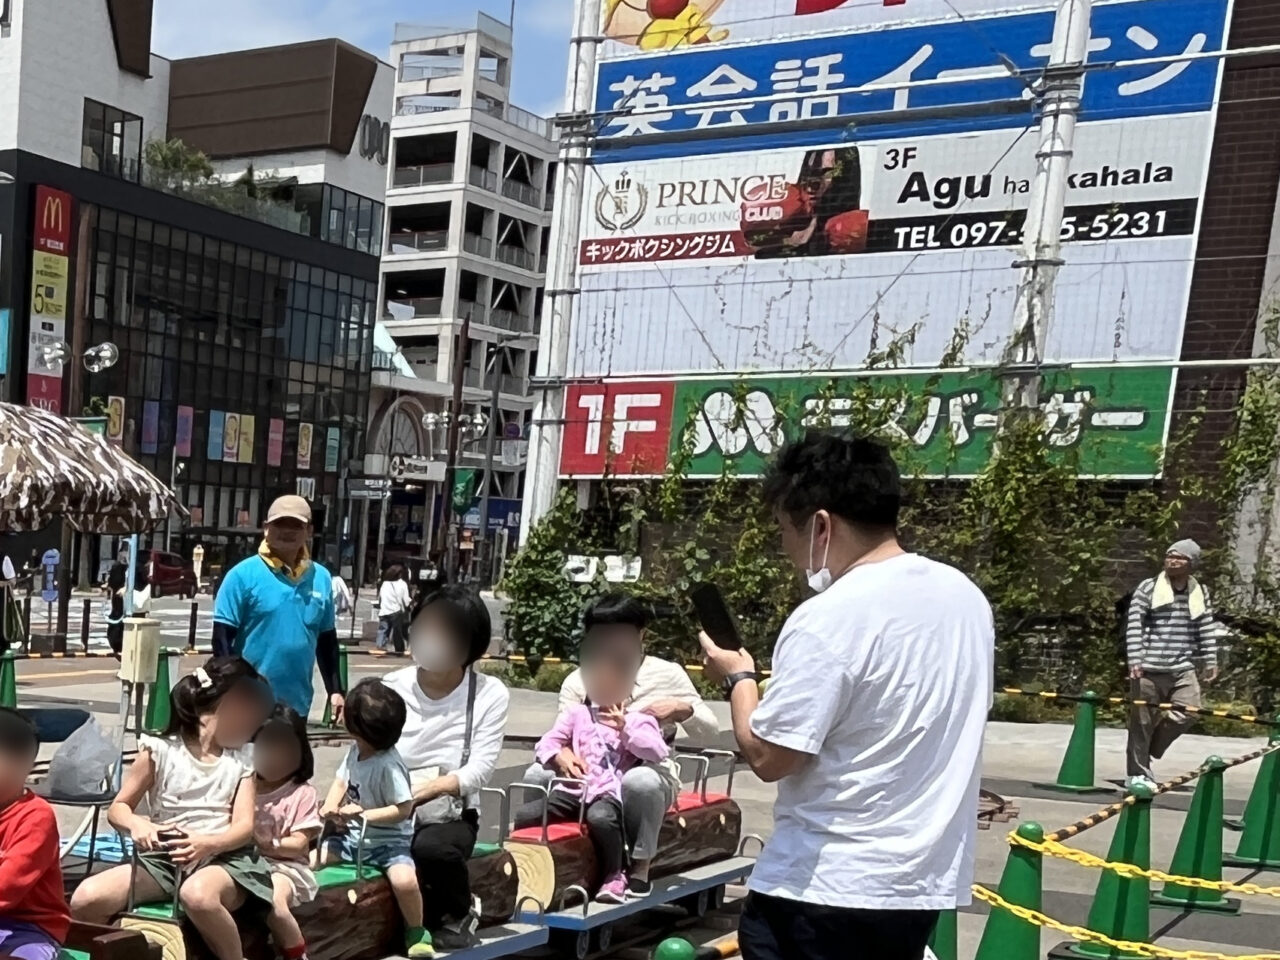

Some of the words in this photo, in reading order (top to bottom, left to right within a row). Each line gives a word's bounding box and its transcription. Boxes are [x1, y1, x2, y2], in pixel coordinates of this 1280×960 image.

[884, 147, 917, 170] 3F
[656, 173, 788, 208] PRINCE
[897, 171, 991, 209] Agu
[894, 226, 941, 249] TEL
[951, 211, 1167, 246] 097-5-5231
[586, 235, 735, 262] キックボクシングジム
[579, 394, 662, 454] 1F
